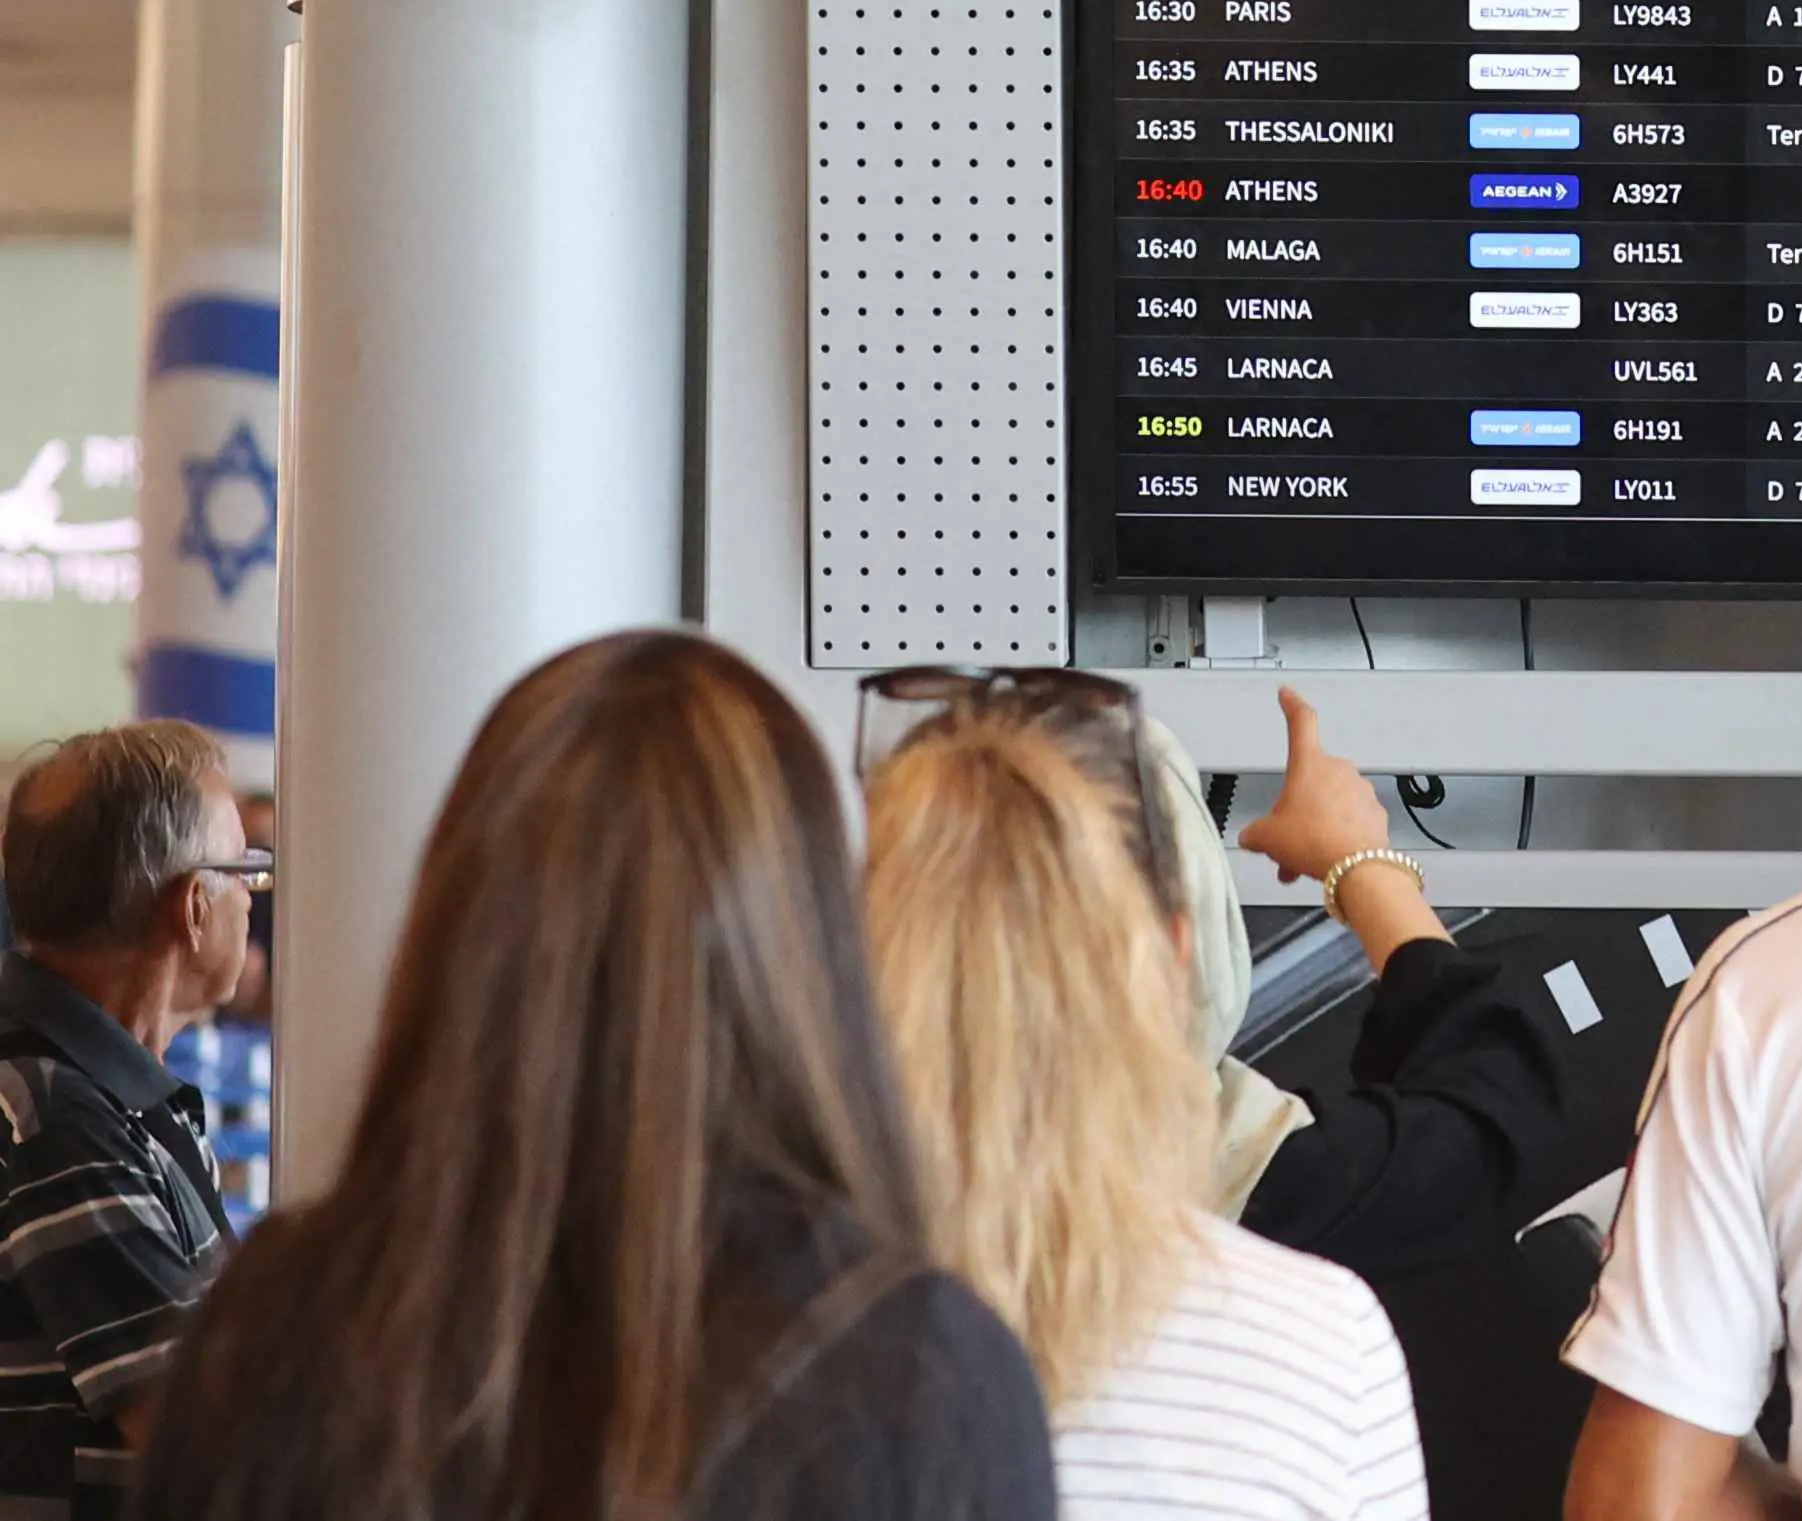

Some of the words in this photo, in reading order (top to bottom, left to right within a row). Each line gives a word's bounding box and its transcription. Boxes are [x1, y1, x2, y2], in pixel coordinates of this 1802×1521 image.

[1136, 119, 1197, 141] 16:35
[1224, 120, 1394, 143] THESSALONIKI
[1612, 123, 1685, 145] 6H573
[1136, 179, 1204, 201] 16:40
[1224, 180, 1318, 203] ATHENS
[1482, 185, 1552, 199] AEGEAN
[1612, 182, 1683, 205] A3927
[1137, 356, 1198, 378] 16:45
[1227, 357, 1334, 380] LARNACA
[1614, 360, 1698, 382] UVL561
[1766, 361, 1783, 383] A
[1138, 475, 1198, 497] 16:55
[1228, 476, 1281, 497] NEW
[1285, 476, 1349, 498] YORK
[1614, 479, 1676, 501] LY011
[1767, 480, 1784, 501] D
